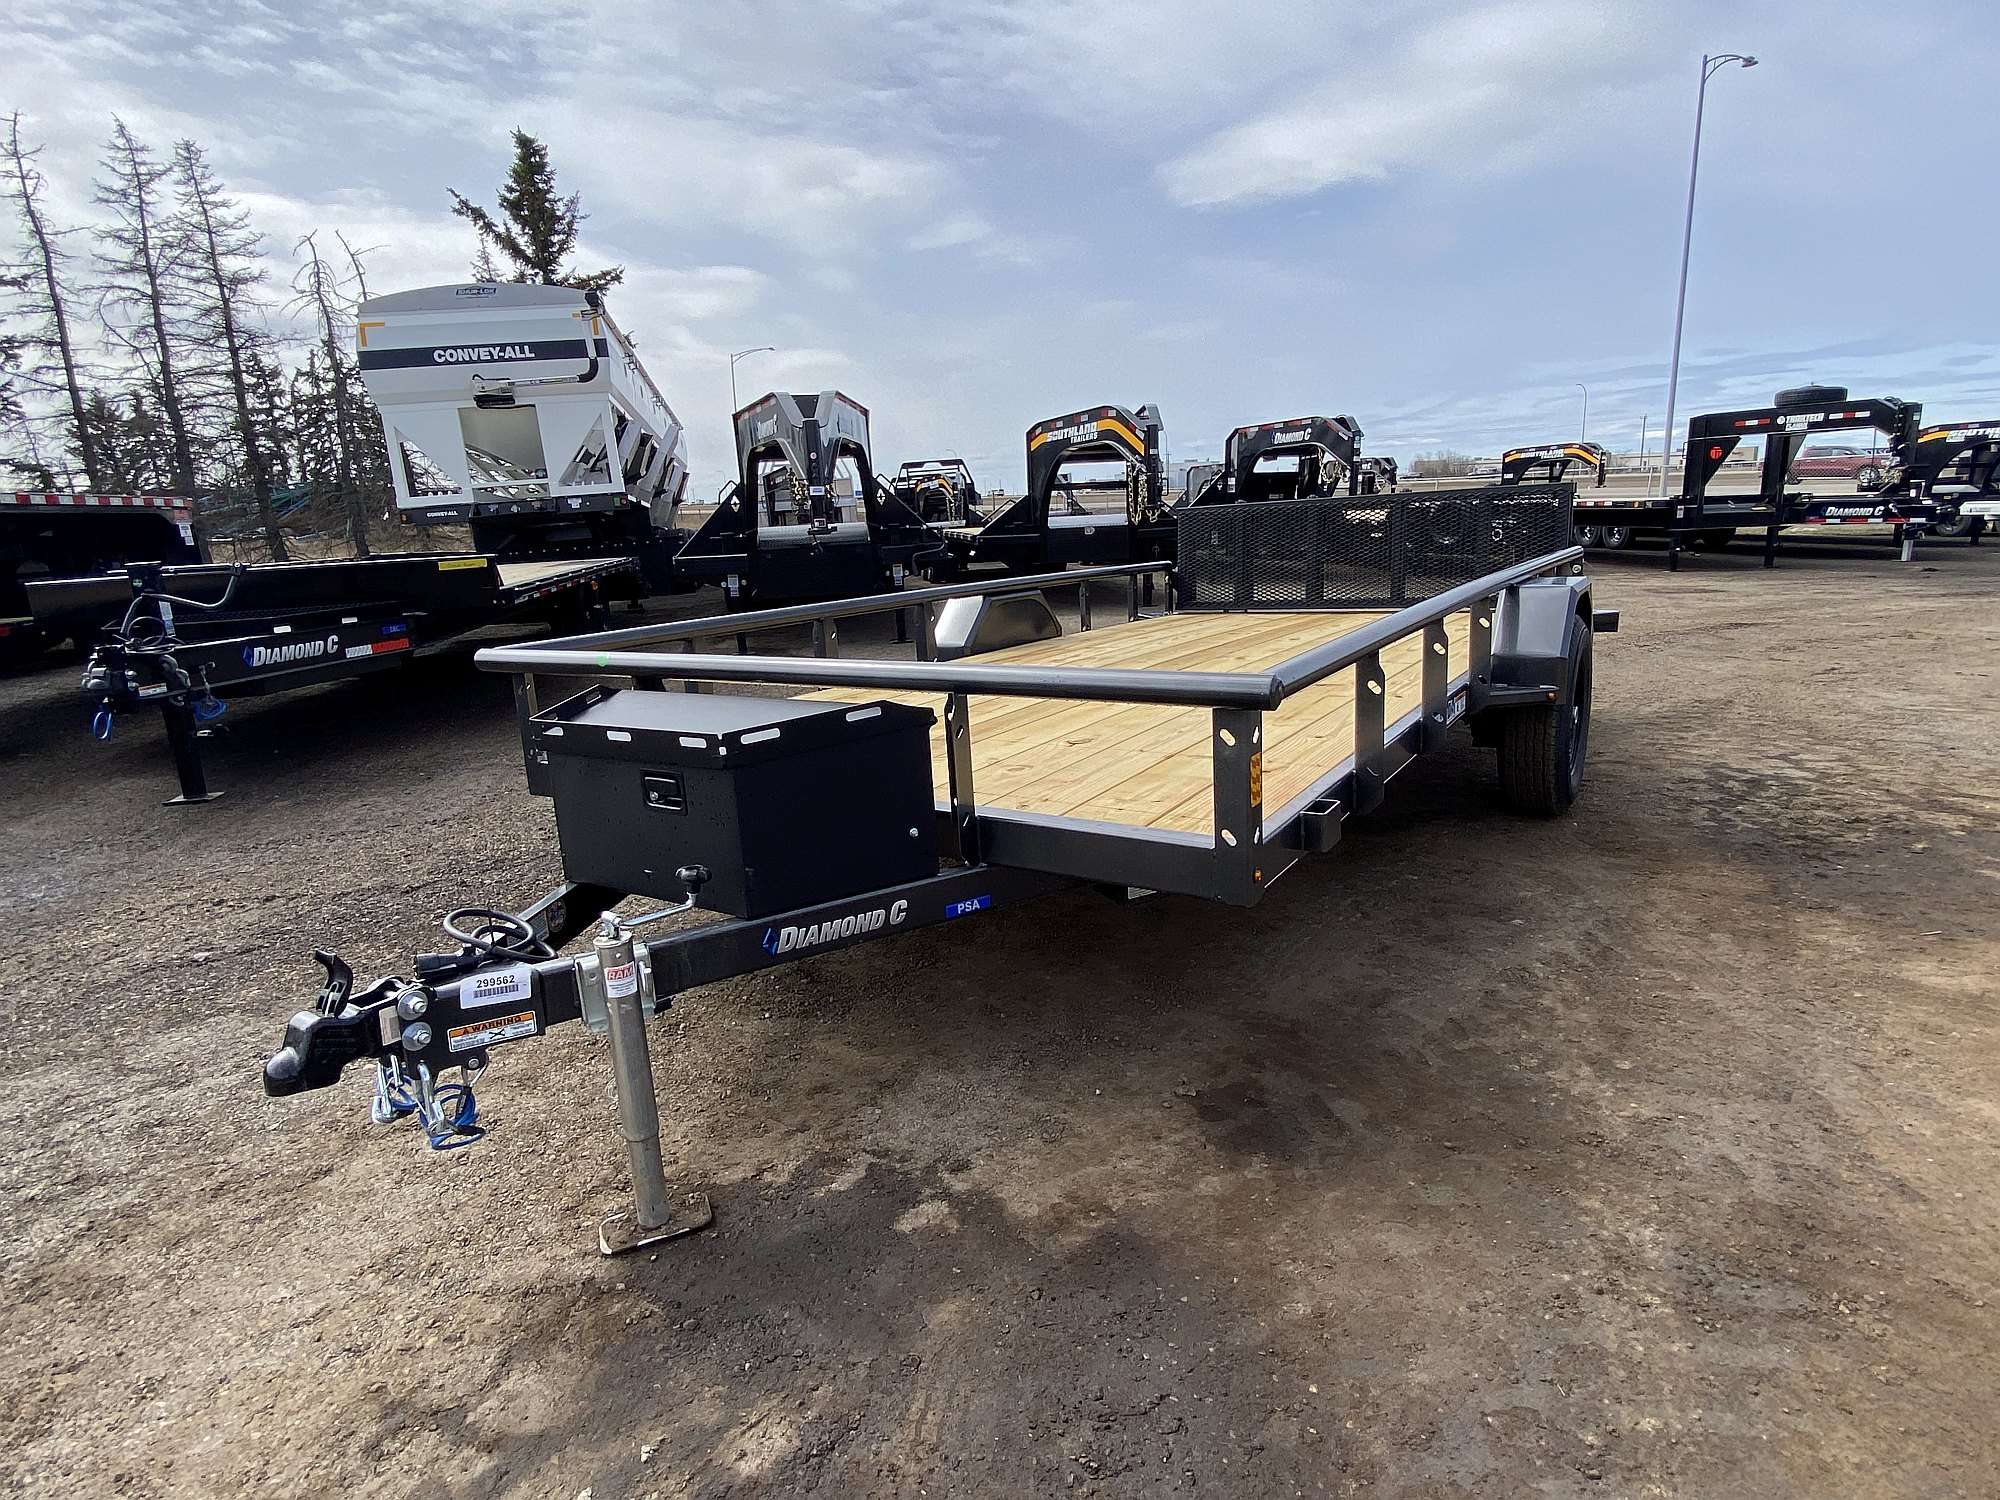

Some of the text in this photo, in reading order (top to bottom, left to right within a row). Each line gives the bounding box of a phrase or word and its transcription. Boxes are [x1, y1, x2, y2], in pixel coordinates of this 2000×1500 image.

[433, 345, 535, 363] CONVEY-ALL
[1047, 421, 1097, 442] SOUTHLAND
[1070, 432, 1098, 444] TRAILERS
[1274, 428, 1312, 444] DIAMOND C
[1825, 506, 1885, 516] DIAMOND C
[253, 635, 339, 667] DIAMOND C
[957, 900, 980, 914] PSA
[777, 900, 908, 953] DIAMOND C
[608, 966, 634, 980] RAM
[476, 975, 515, 989] 299562
[471, 1015, 522, 1033] WARNING
